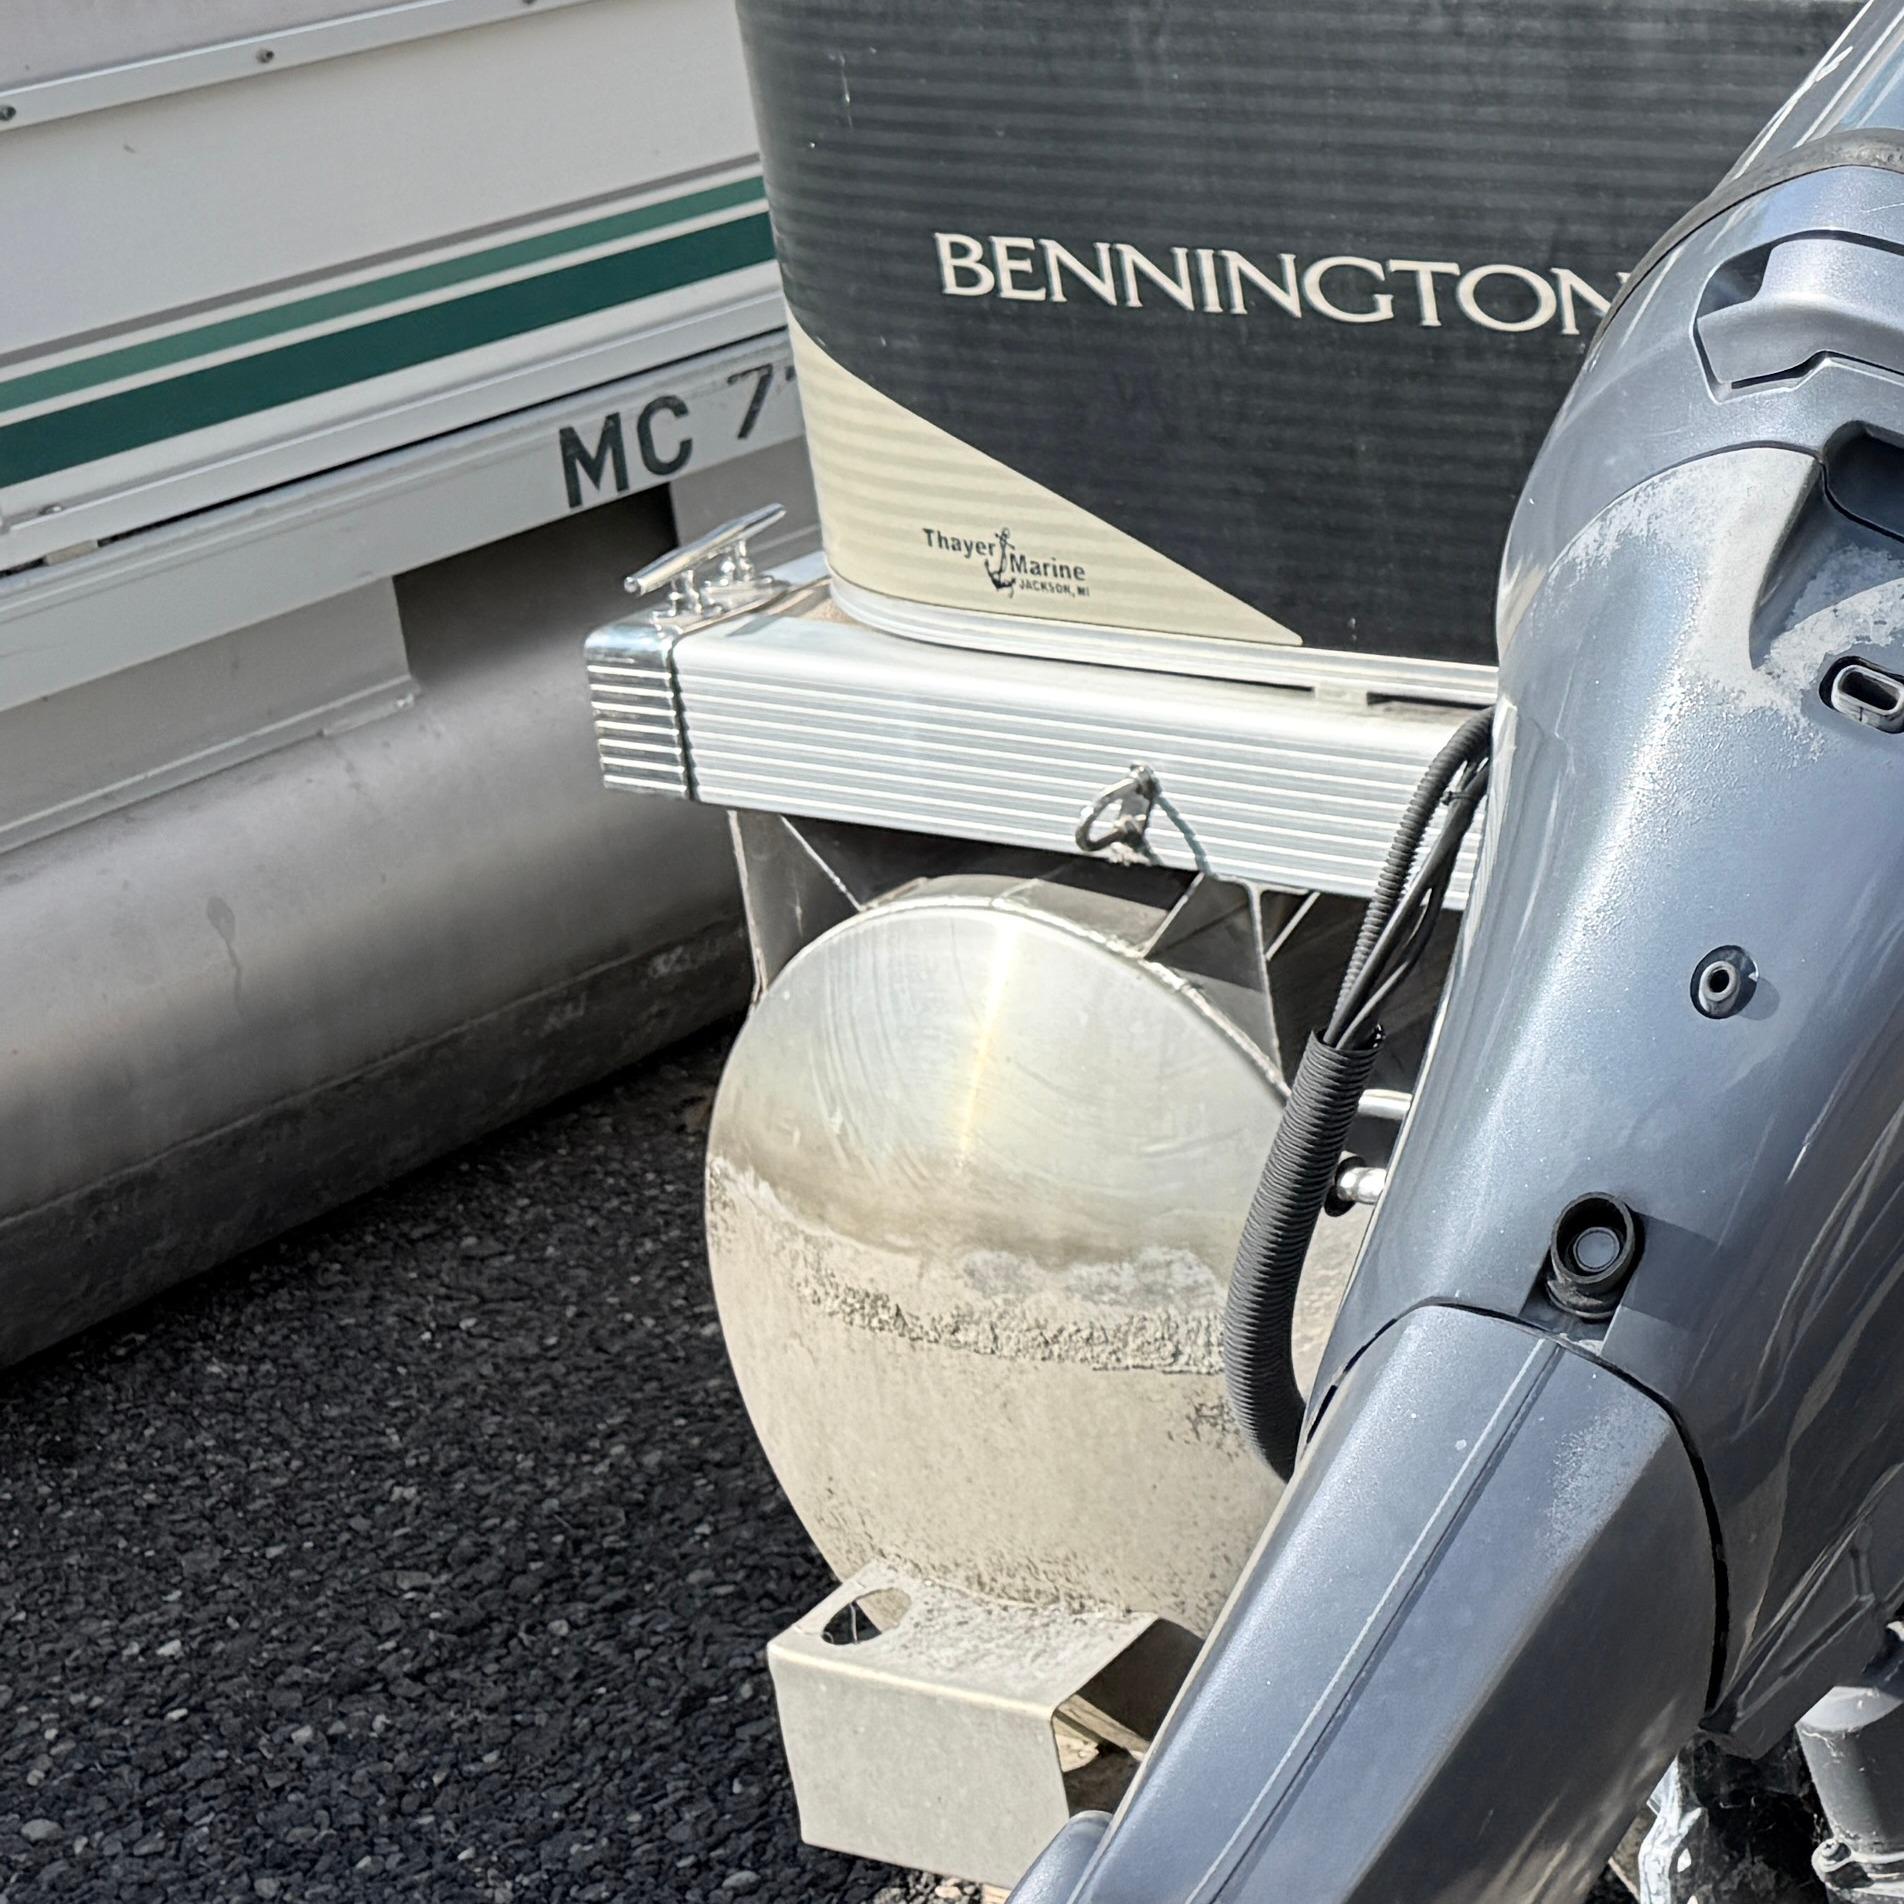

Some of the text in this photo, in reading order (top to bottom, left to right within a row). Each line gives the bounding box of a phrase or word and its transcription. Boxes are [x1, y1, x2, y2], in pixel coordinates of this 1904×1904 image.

[934, 232, 1632, 335] BENNINGTON
[558, 362, 796, 509] MC 7
[922, 527, 1087, 582] Thayer Marine
